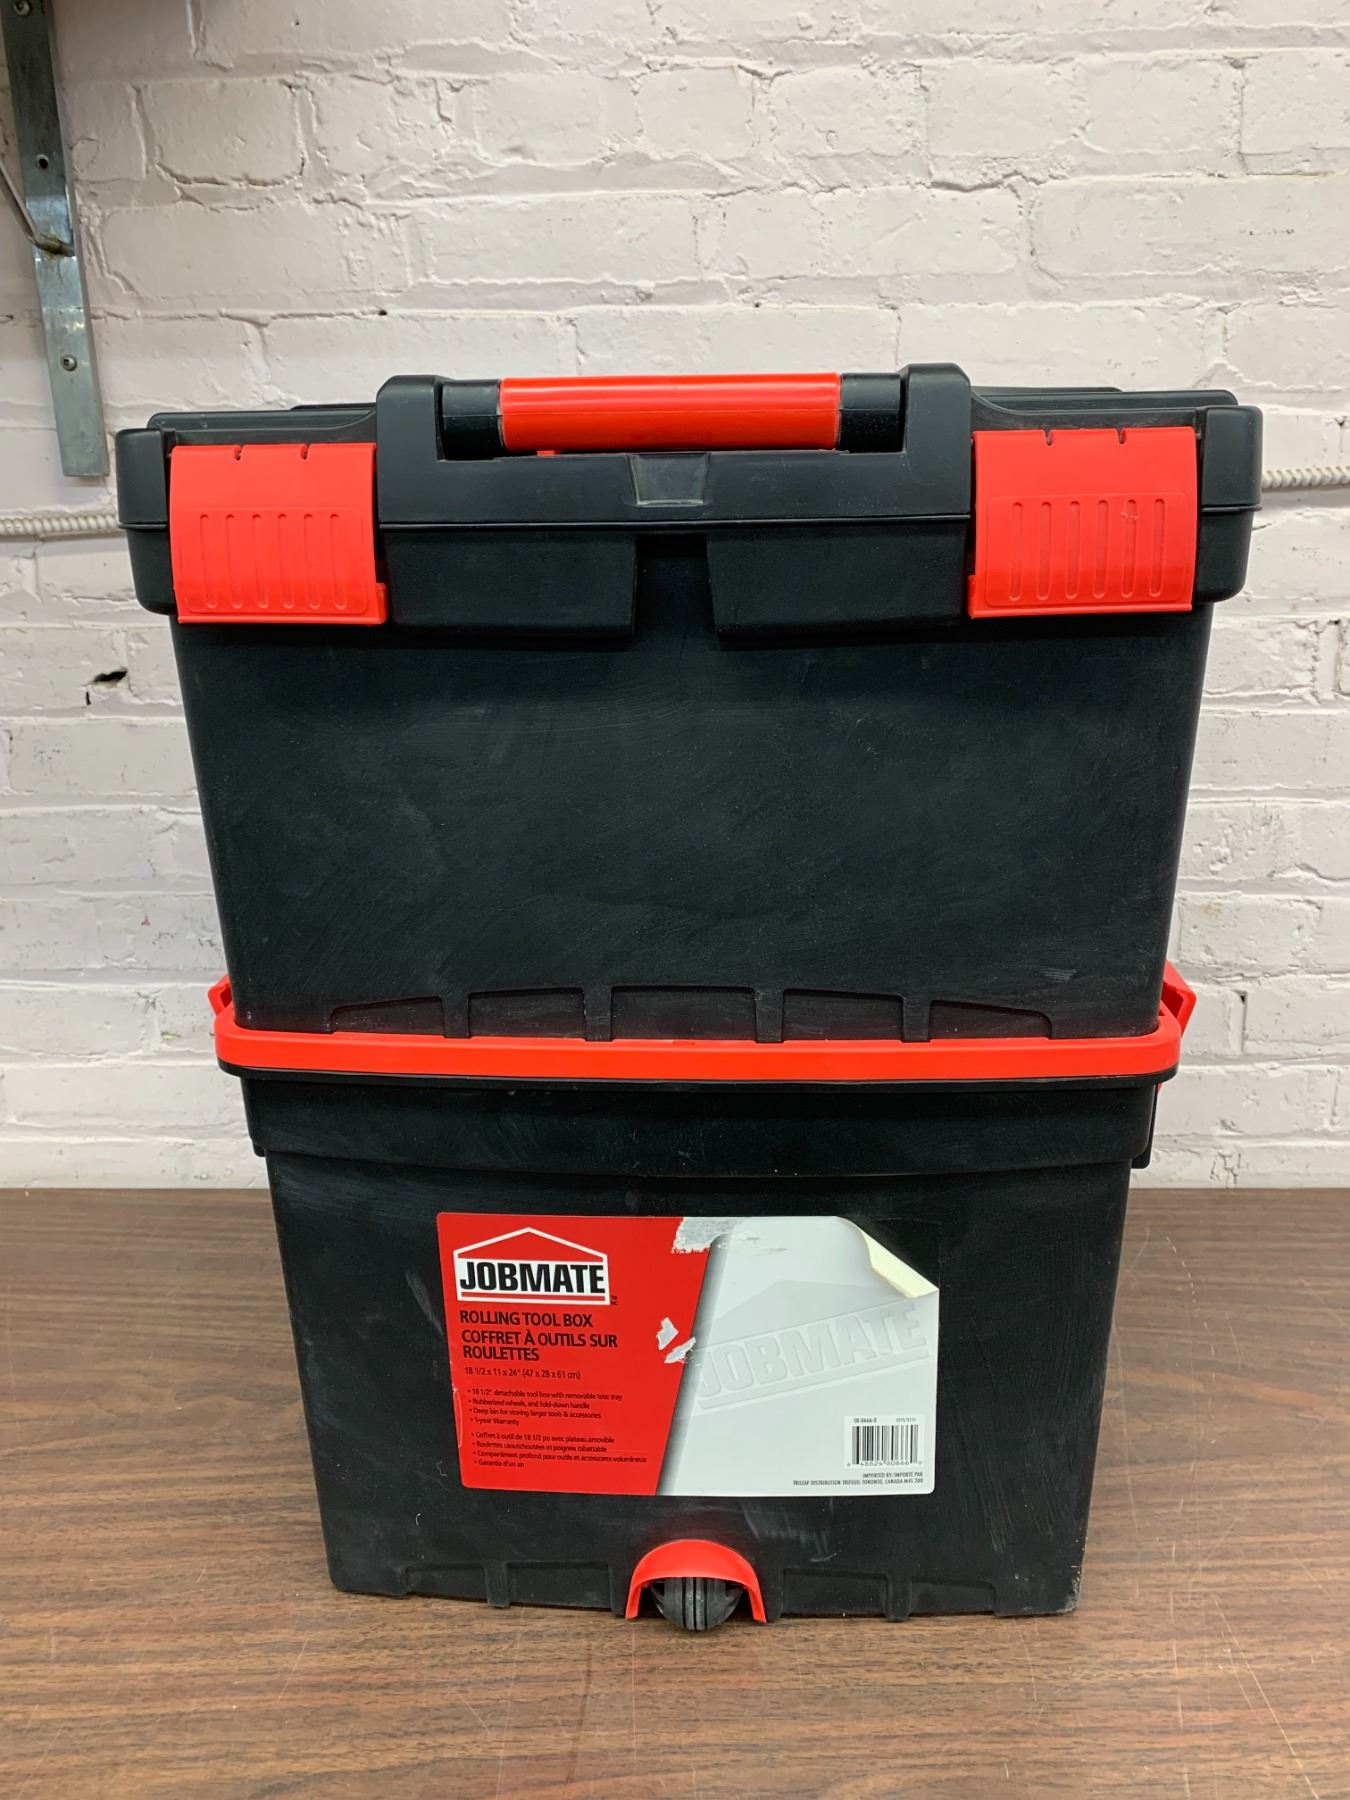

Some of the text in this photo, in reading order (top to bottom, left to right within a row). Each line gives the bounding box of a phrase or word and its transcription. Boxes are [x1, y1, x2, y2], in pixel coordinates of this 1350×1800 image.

[460, 1261, 606, 1293] JOBMATE
[460, 1310, 593, 1328] ROLLING TOOL BOX
[461, 1329, 618, 1348] COFFRET À OUTILS SUR
[463, 1345, 540, 1361] ROULETTES
[697, 1301, 927, 1398] JOBMATE
[464, 1366, 473, 1375] 18
[475, 1367, 486, 1376] 1/2
[493, 1367, 501, 1376] 11
[522, 1369, 533, 1379] (47
[541, 1370, 550, 1378] 28
[556, 1370, 566, 1378] 61
[567, 1370, 581, 1380] cm)
[494, 1389, 525, 1397] detachable
[526, 1390, 538, 1398] tool
[550, 1391, 564, 1399] with
[565, 1392, 596, 1400] removable
[610, 1394, 622, 1402] tray
[472, 1398, 505, 1406] Rubberized
[527, 1400, 538, 1408] and
[539, 1401, 569, 1409] fold-down
[473, 1407, 488, 1415] Deep
[509, 1409, 529, 1418] storing
[530, 1410, 547, 1418] larger
[547, 1410, 562, 1418] tools
[569, 1411, 602, 1419] accessories
[474, 1416, 519, 1426] 1-year Warranty
[475, 1431, 496, 1439] Coffret
[577, 1445, 608, 1453] rabattable
[519, 1452, 541, 1460] profond
[478, 1459, 503, 1467] Garantie
